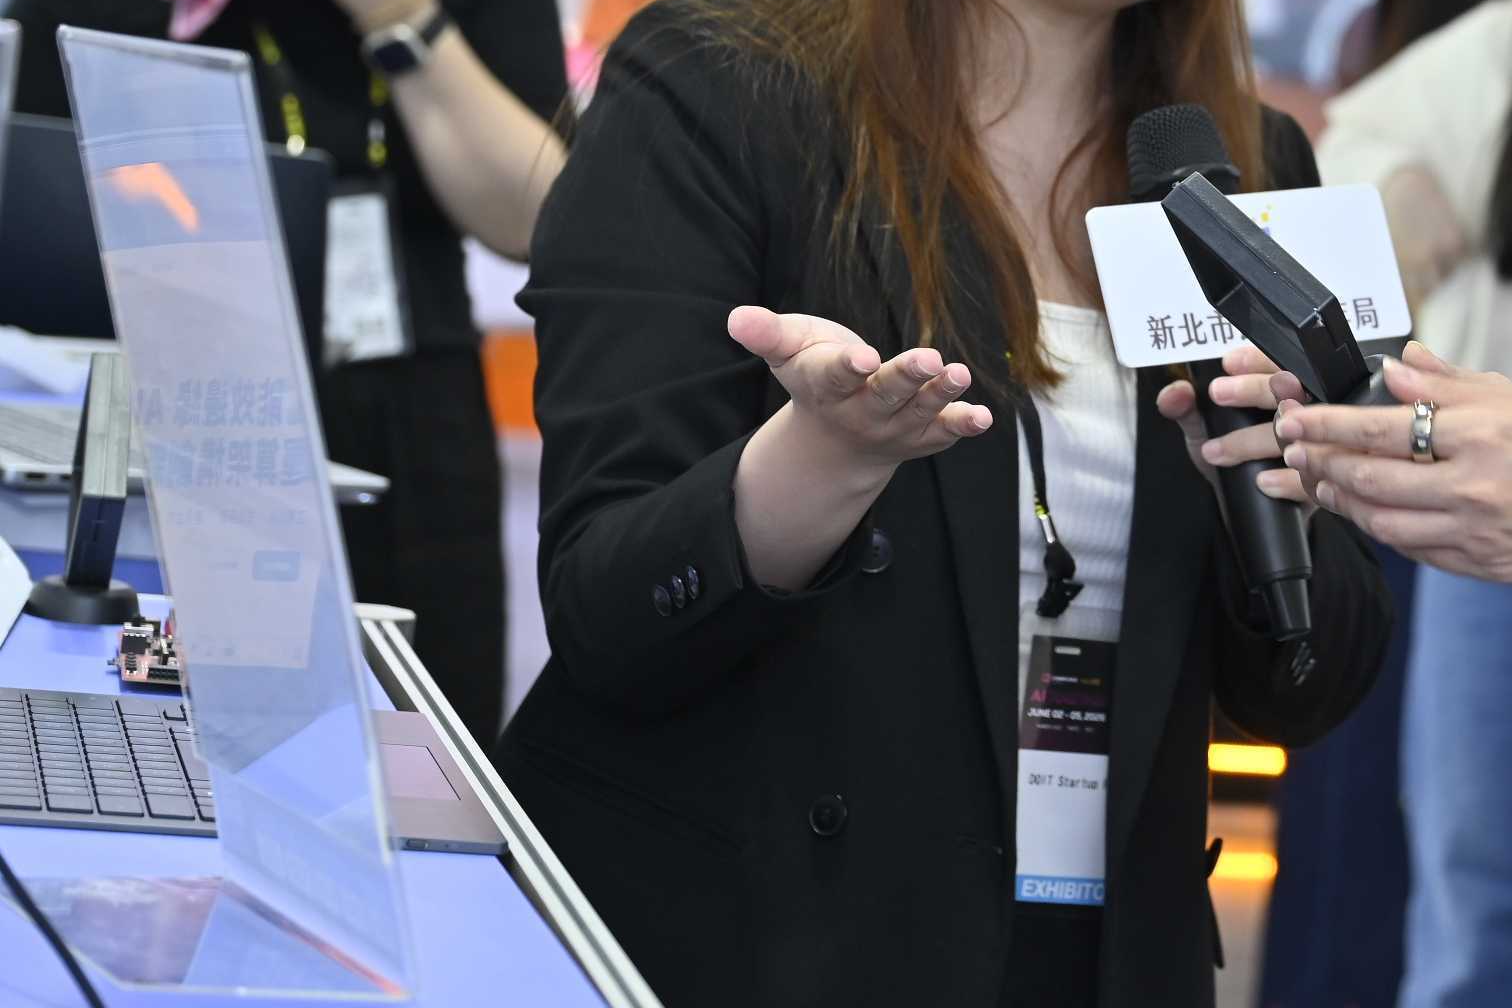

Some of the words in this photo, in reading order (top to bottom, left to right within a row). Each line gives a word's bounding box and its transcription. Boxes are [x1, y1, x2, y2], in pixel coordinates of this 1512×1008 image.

[1147, 297, 1380, 350] 新北市局
[1057, 775, 1098, 792] Startup
